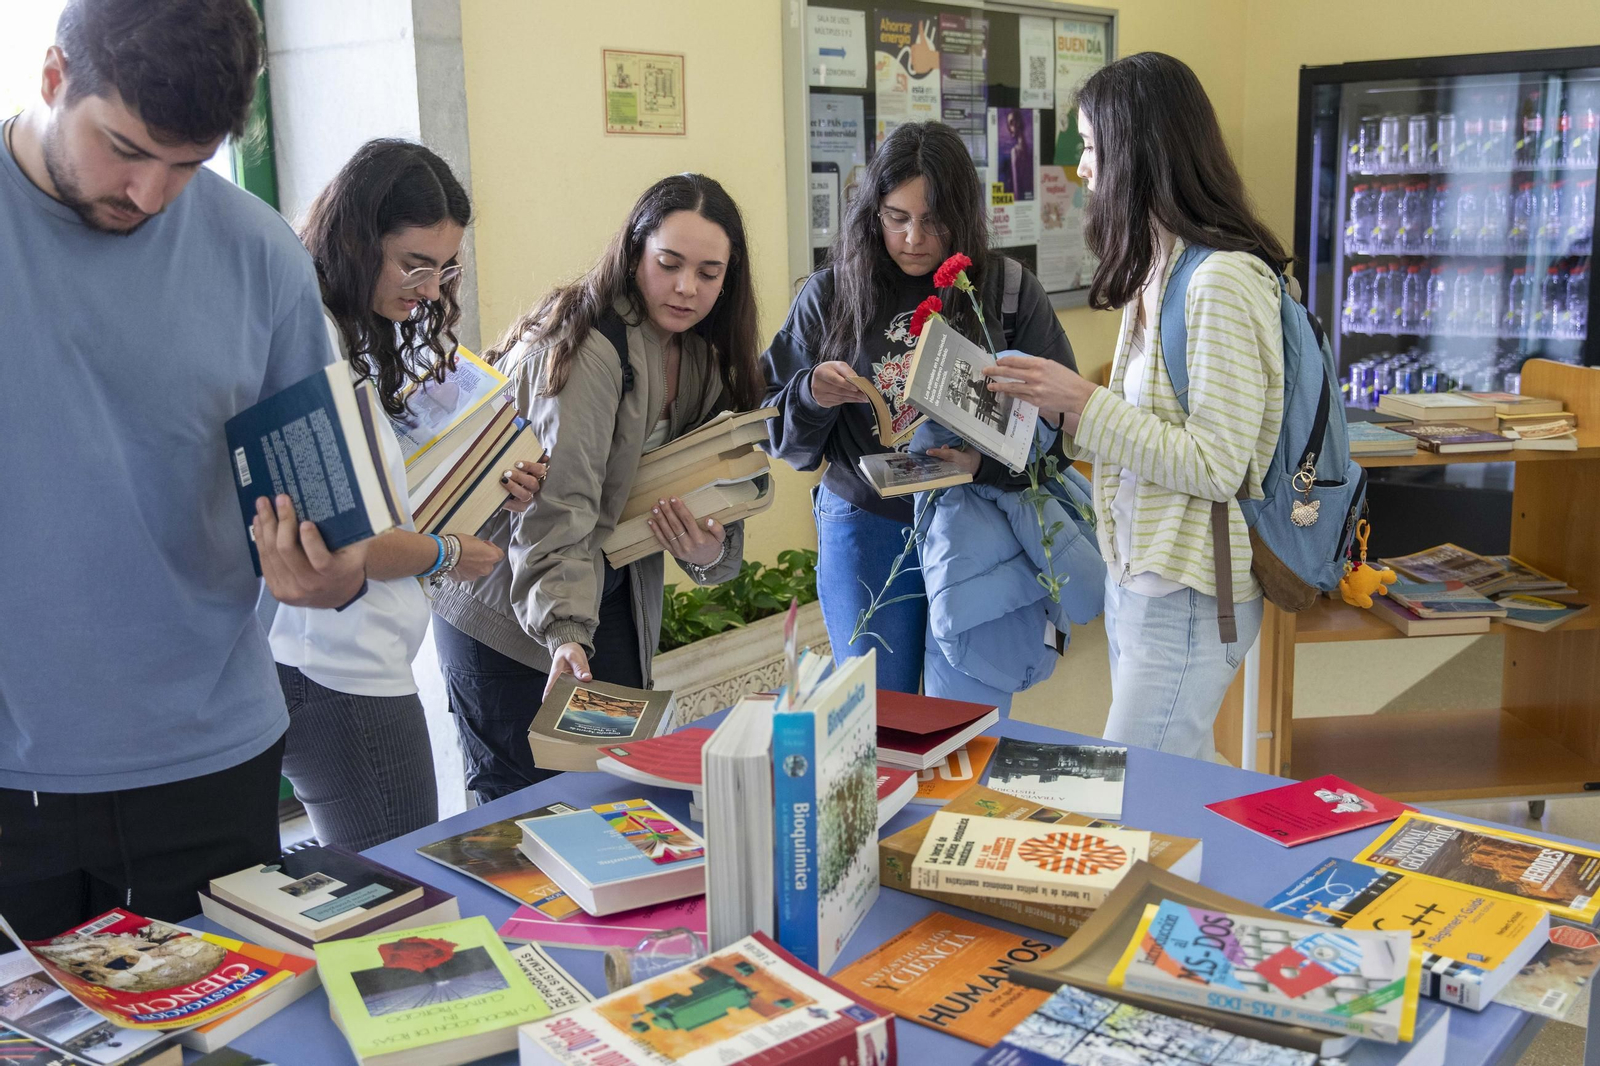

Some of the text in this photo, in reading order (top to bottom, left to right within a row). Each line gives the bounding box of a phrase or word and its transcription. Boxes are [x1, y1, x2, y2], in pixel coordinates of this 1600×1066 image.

[881, 17, 912, 33] Ahorrar
[1057, 36, 1085, 53] BUEN
[927, 368, 937, 391] animales
[1387, 827, 1430, 859] NATIONAL
[1397, 824, 1456, 871] GEOGRAPHIC
[1519, 848, 1565, 884] HERODES
[1051, 888, 1060, 898] de
[1082, 891, 1091, 901] La
[1428, 913, 1467, 944] Beginner's
[1460, 897, 1486, 918] Guide
[874, 977, 899, 993] Y
[890, 934, 976, 986] CIENCIA
[1178, 914, 1235, 985] MS-DOS
[113, 963, 250, 1013] CIENCIA
[520, 951, 580, 1004] PARA SISTEMAS
[918, 938, 1053, 1027] HUMANOS
[385, 1004, 452, 1025] PROTEGIDO
[1207, 992, 1278, 1018] MS-DOS
[371, 1032, 409, 1047] ROSAS
[412, 1028, 430, 1040] DE
